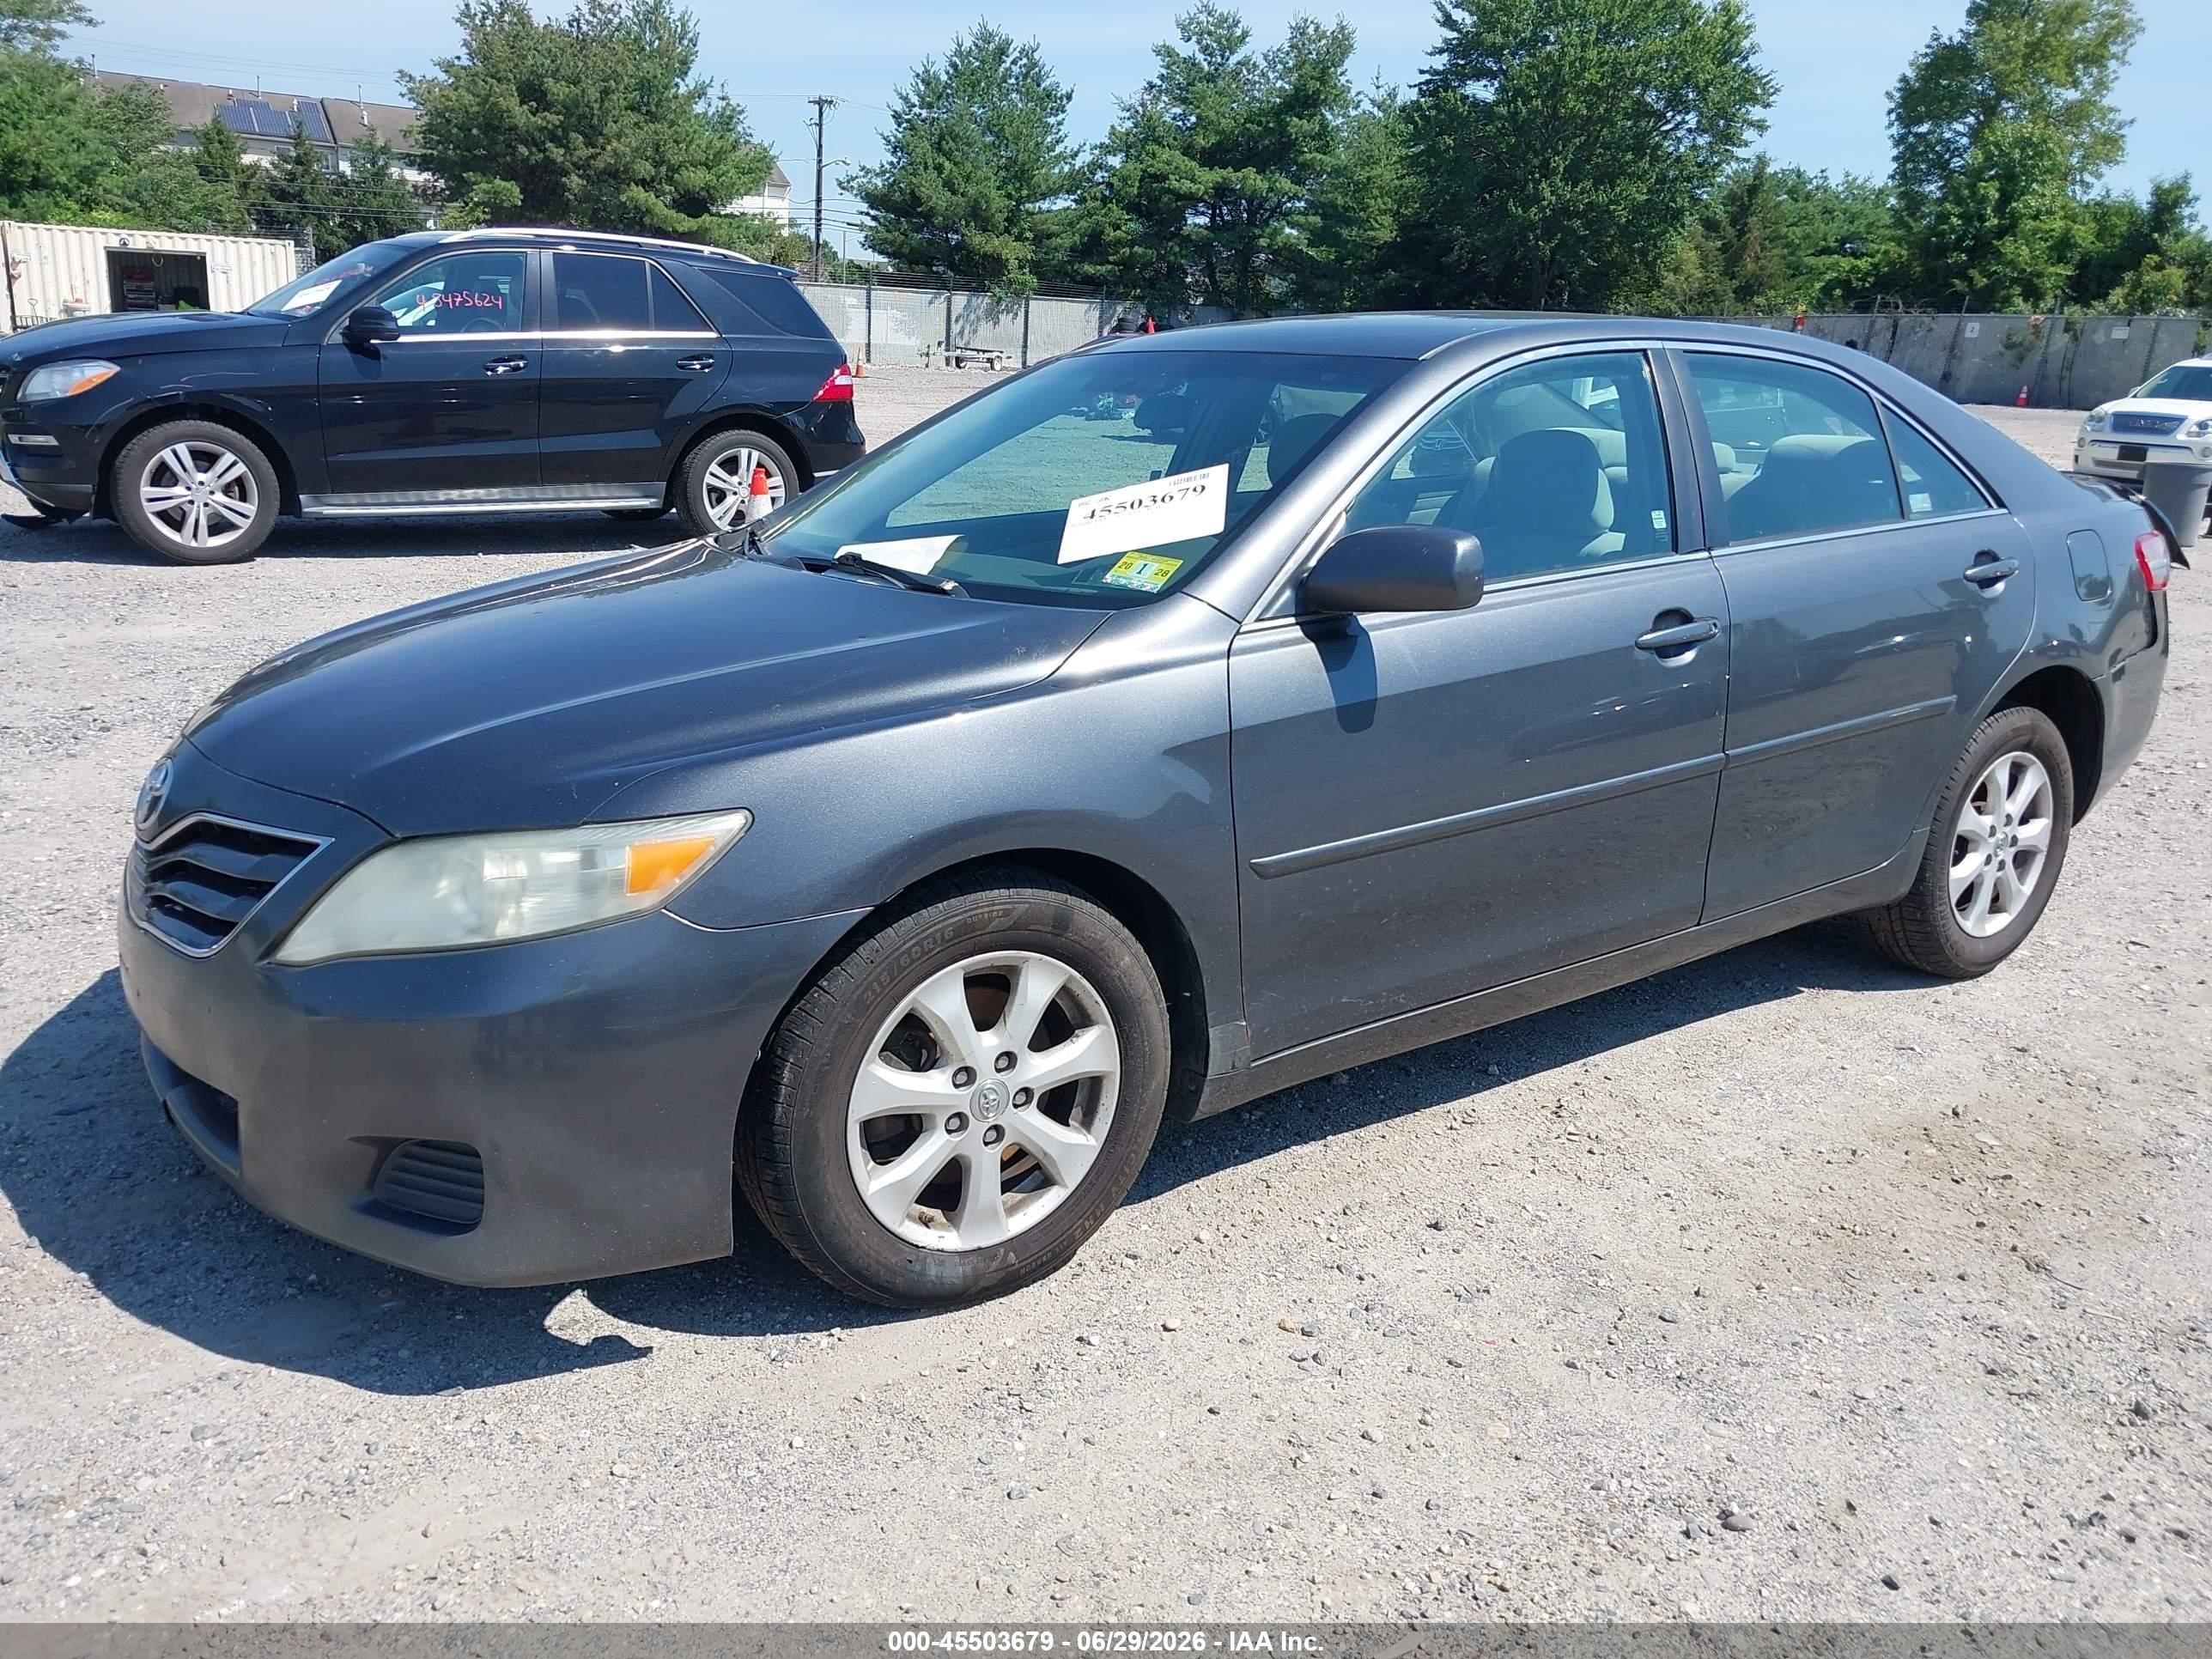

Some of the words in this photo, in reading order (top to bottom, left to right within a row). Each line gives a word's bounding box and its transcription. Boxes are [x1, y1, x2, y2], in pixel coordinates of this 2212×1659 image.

[1083, 484, 1206, 520] 45503679
[1118, 561, 1133, 570] 20
[1135, 563, 1149, 574] 1
[1154, 568, 1170, 578] 28
